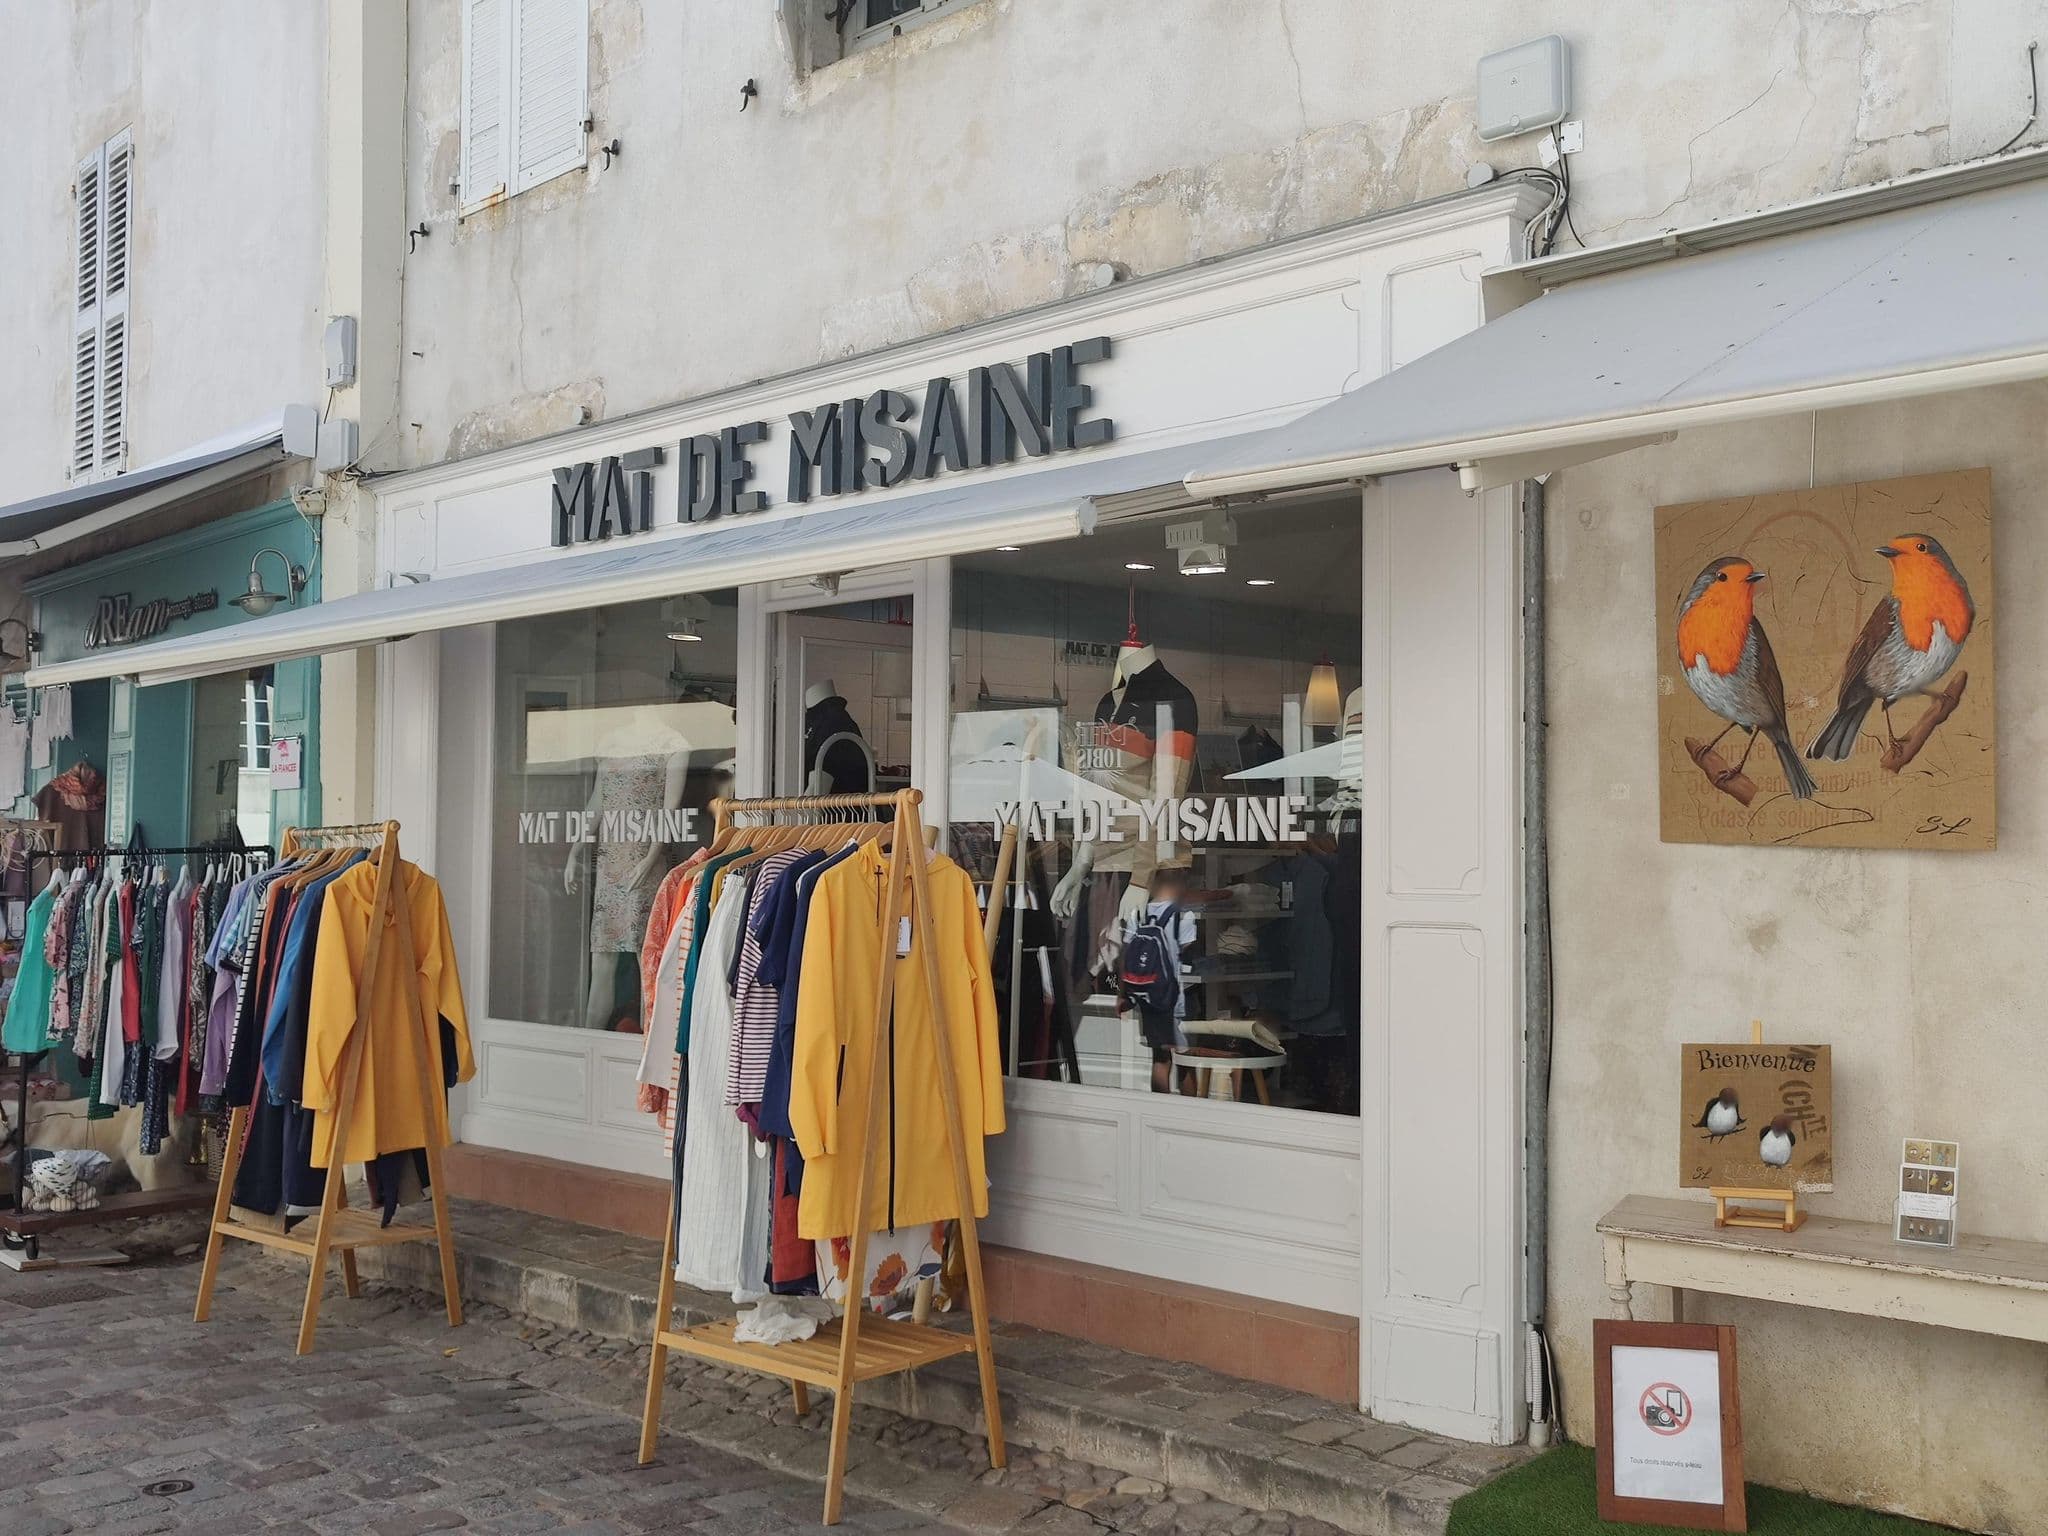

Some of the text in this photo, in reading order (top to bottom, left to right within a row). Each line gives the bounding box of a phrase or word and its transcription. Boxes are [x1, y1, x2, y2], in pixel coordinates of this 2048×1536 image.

[551, 337, 1113, 547] MAT DE MISAINE
[1065, 641, 1089, 656] MAT
[1091, 644, 1108, 658] DE
[518, 807, 699, 844] MAT DE MISAINE
[992, 795, 1307, 842] MAT DE MISAINE
[1696, 1048, 1816, 1073] Bienvenue
